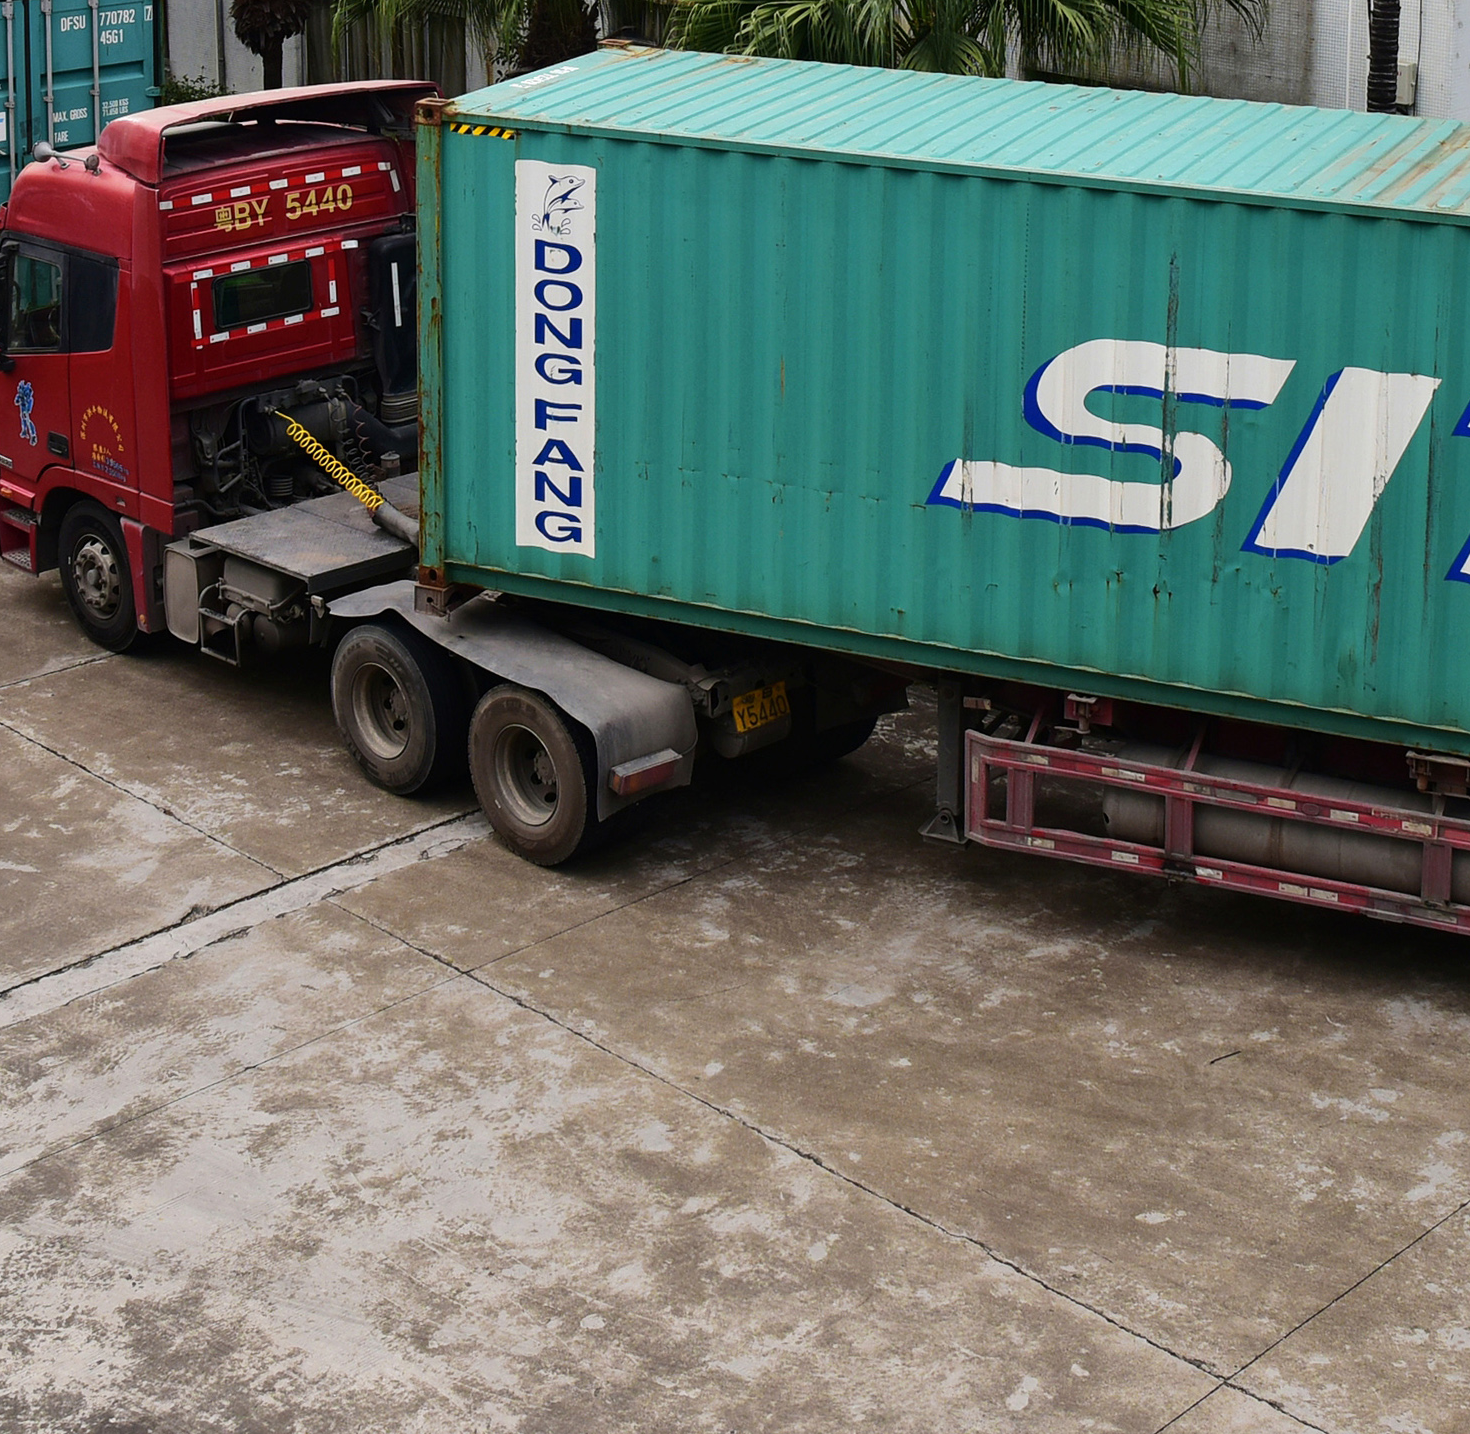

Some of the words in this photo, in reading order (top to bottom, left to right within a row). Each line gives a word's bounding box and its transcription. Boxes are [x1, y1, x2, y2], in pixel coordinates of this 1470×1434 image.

[60, 15, 86, 32] DFSU
[99, 8, 136, 27] 770782
[100, 29, 124, 45] 45G1
[70, 107, 88, 121] GROSS
[54, 130, 69, 143] TARE
[286, 184, 353, 220] 5440
[531, 239, 585, 387] DONG
[531, 398, 585, 545] FANG
[737, 695, 788, 729] Y5440
